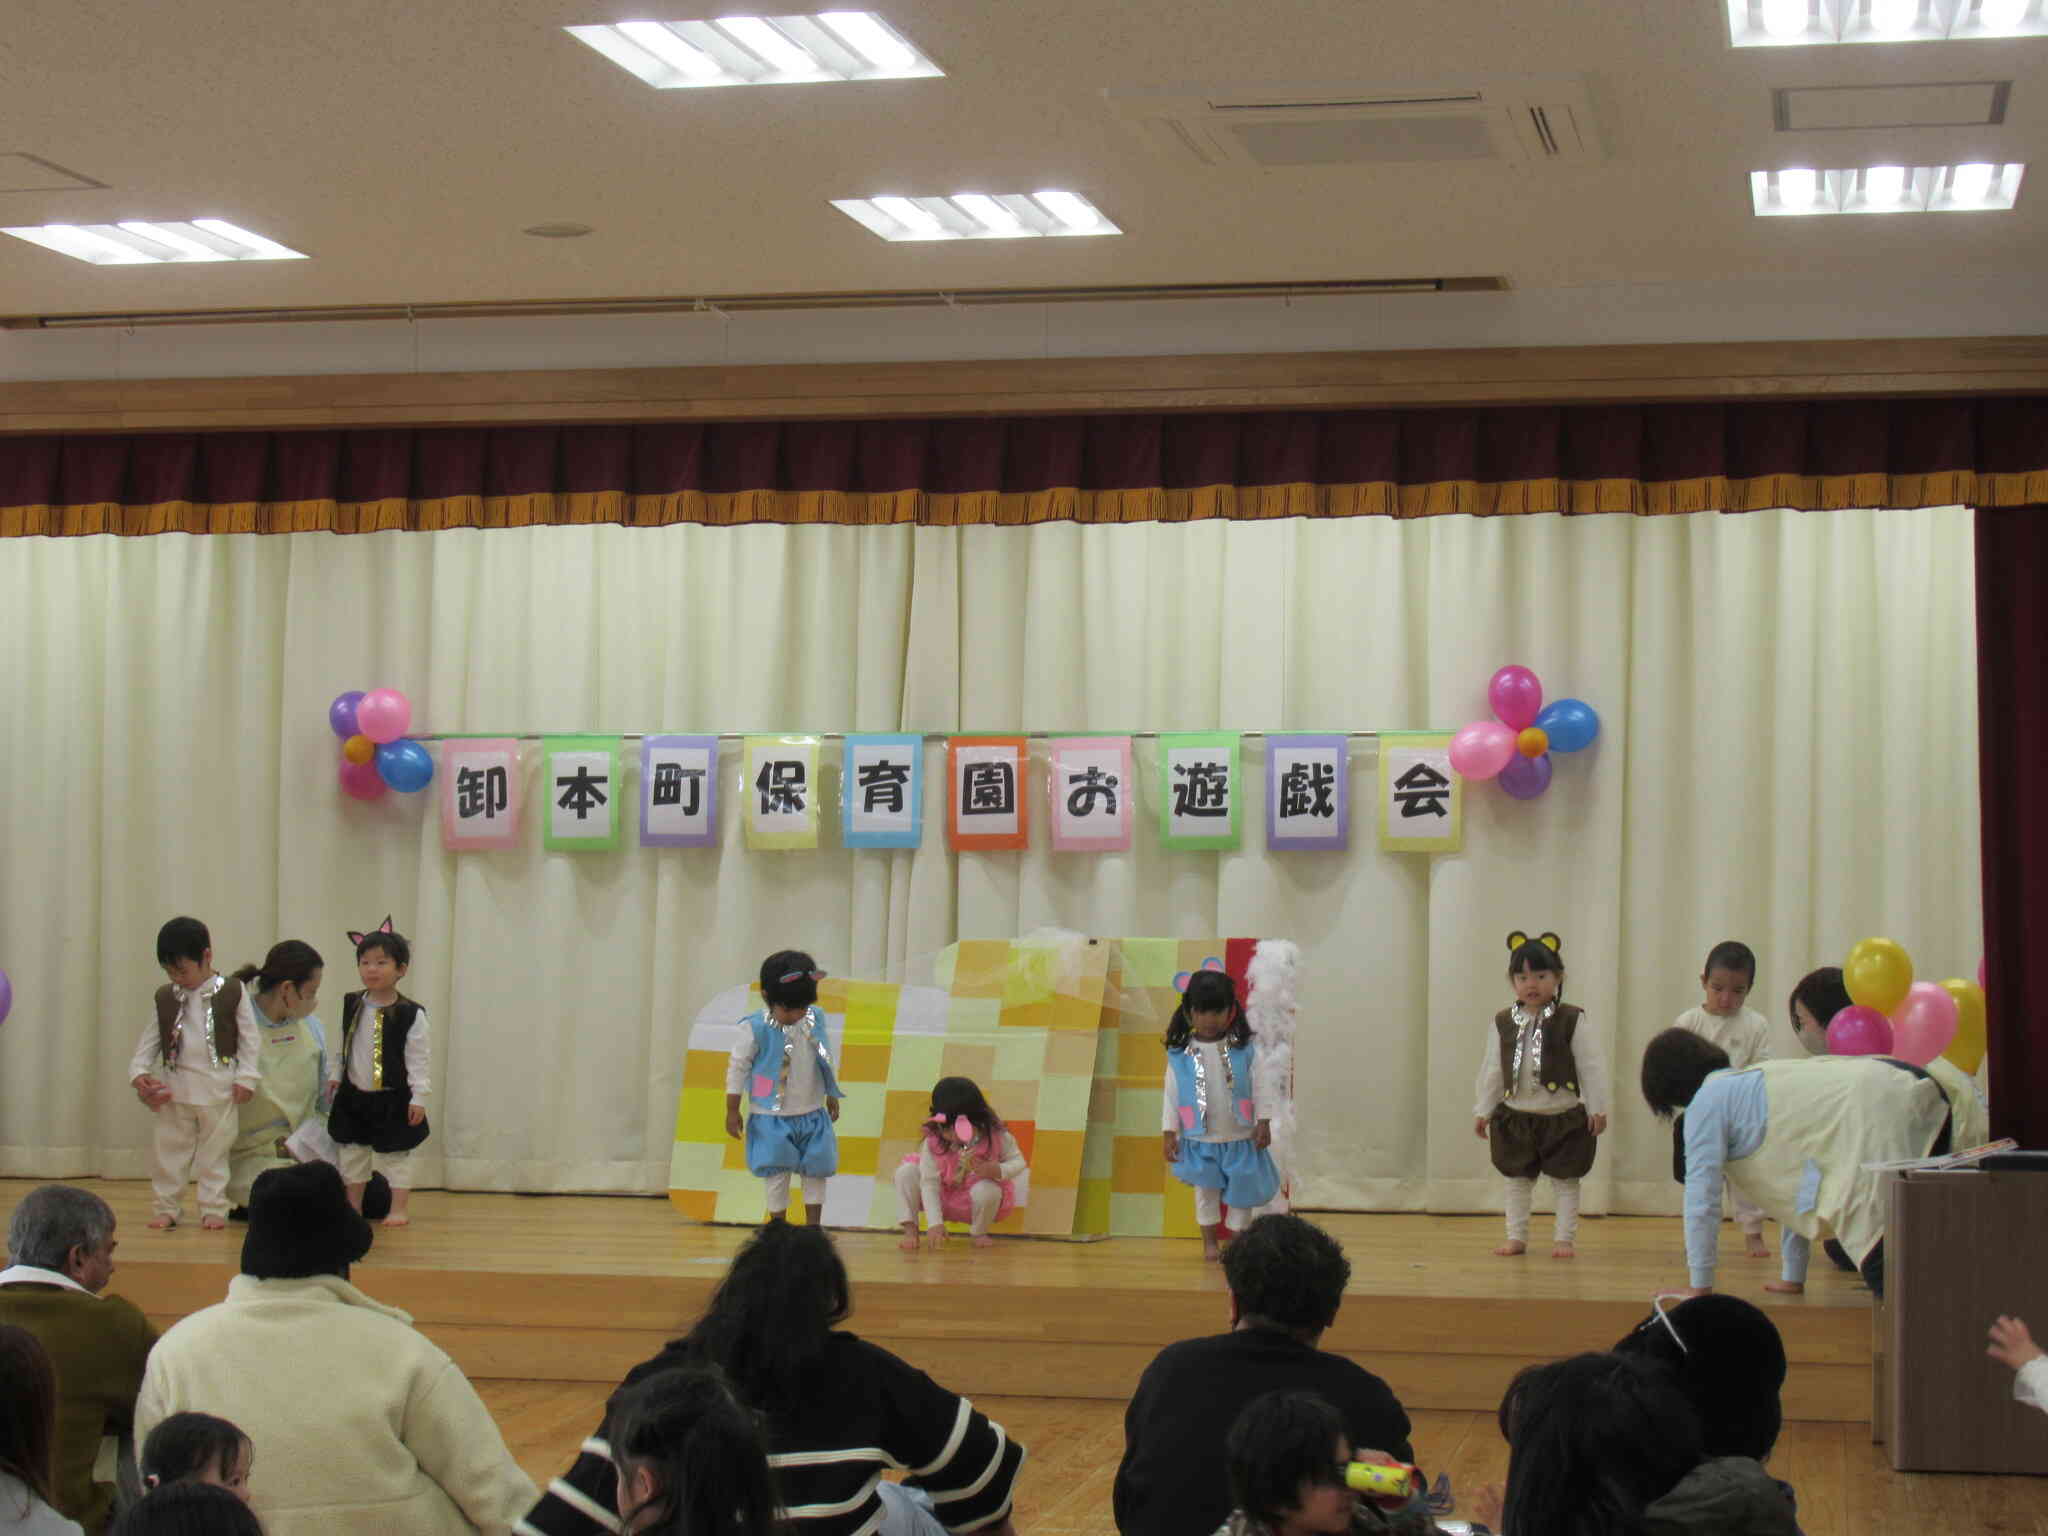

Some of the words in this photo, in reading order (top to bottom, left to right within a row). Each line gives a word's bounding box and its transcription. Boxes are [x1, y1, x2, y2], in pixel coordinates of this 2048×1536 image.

[456, 759, 1450, 819] 卸本町保育園お遊戯会
